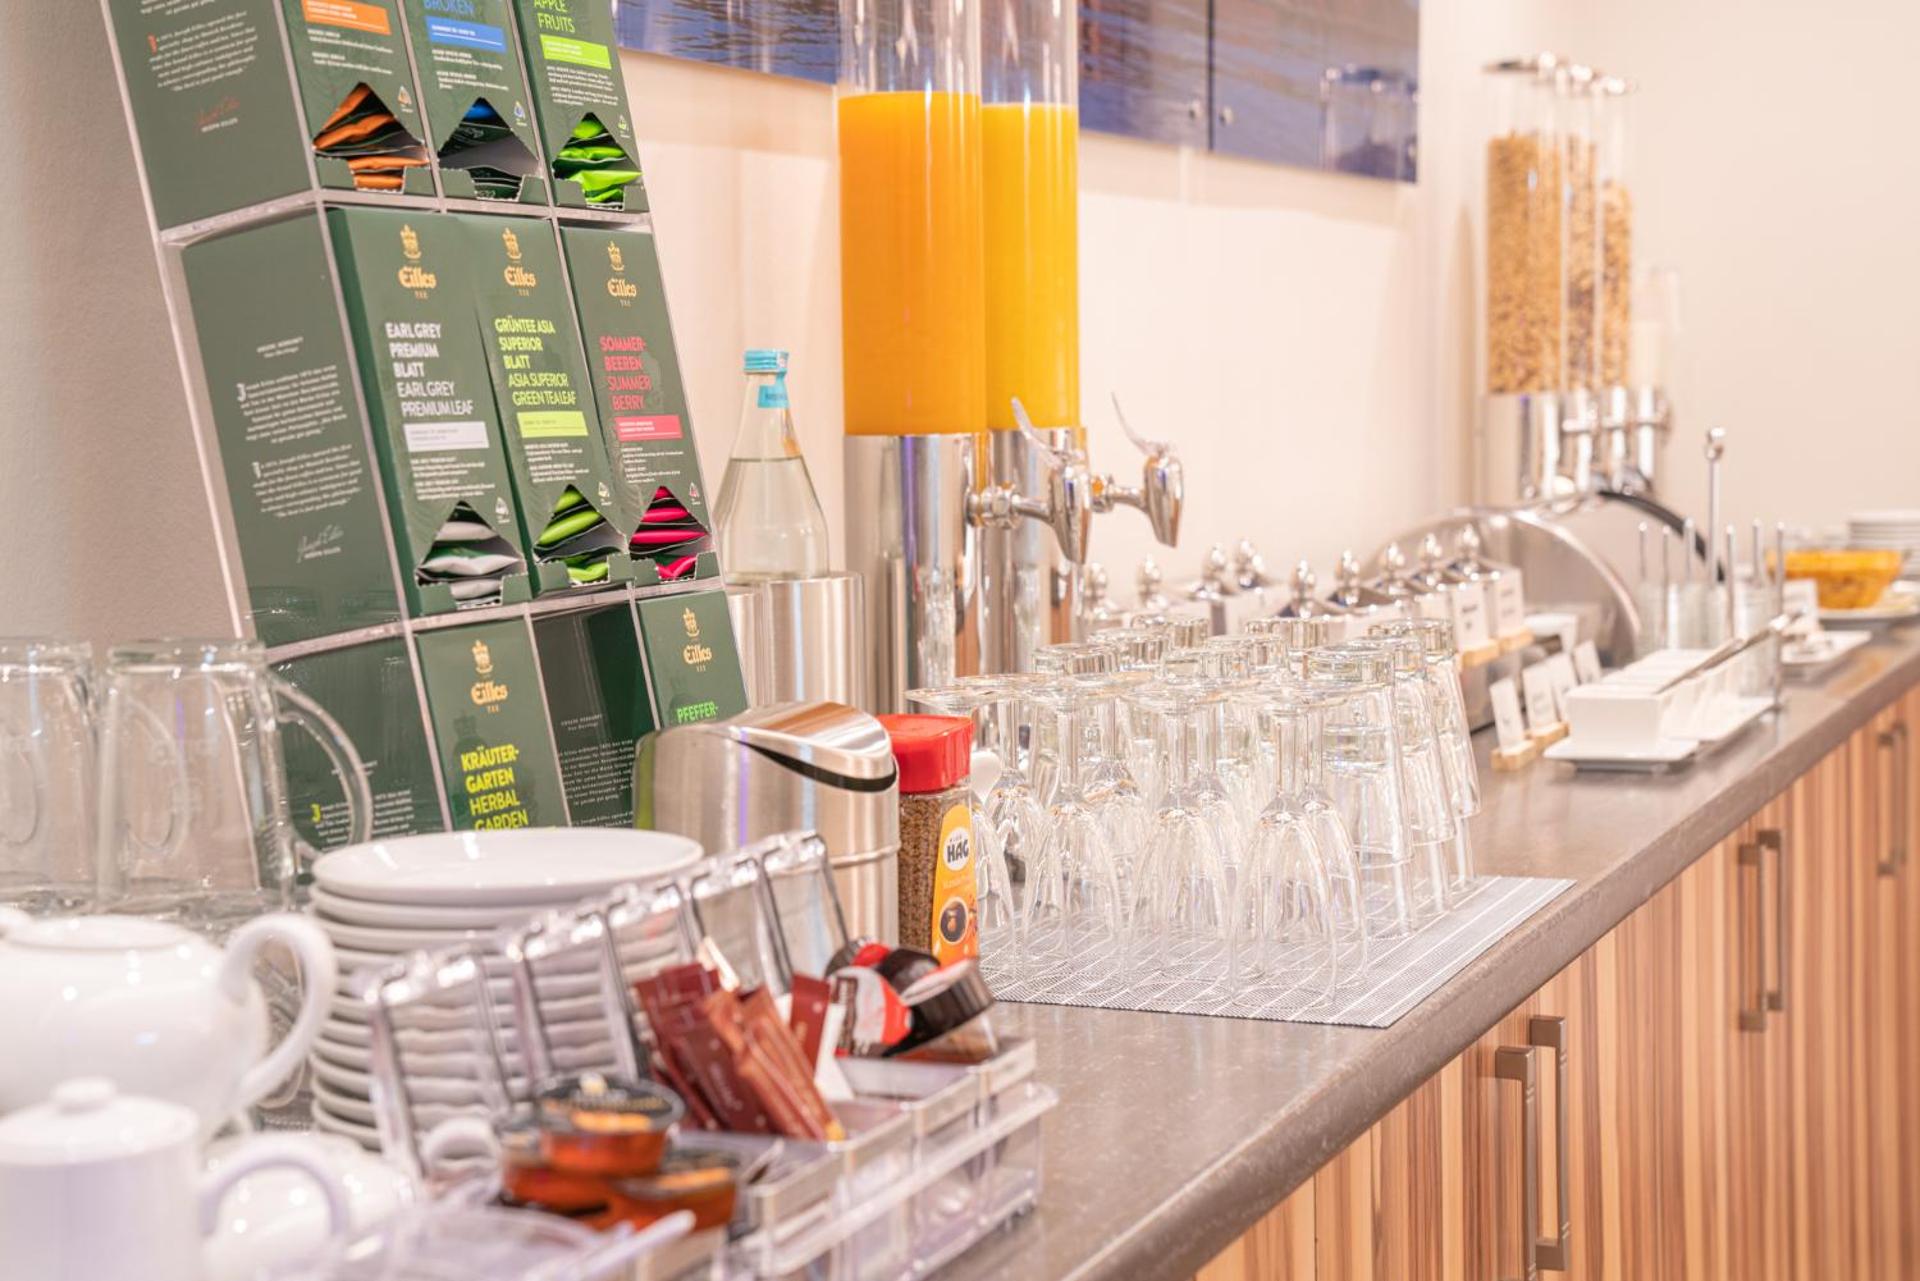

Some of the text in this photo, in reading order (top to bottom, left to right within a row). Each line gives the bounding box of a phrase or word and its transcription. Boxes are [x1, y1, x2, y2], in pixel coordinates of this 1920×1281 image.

[534, 0, 568, 13] APPLE
[537, 13, 575, 33] FRUITS
[398, 266, 437, 289] Eilles
[504, 266, 537, 288] Eilles
[607, 278, 637, 297] Eilles
[385, 322, 441, 338] EARL GREY
[495, 314, 557, 334] GRÜNTEE ASIA
[389, 342, 440, 358] PREMIUM
[499, 336, 544, 351] SUPERIOR
[393, 362, 424, 378] BLATT
[503, 355, 531, 369] BLATT
[604, 356, 642, 371] BEEREN
[397, 381, 455, 397] EARL GREY
[508, 372, 569, 388] ASIA SUPERIOR
[608, 374, 653, 391] SUMMER
[512, 391, 545, 406] GREEN
[612, 394, 644, 410] BERRY
[401, 399, 474, 417] PREMIUM LEAF
[683, 643, 713, 664] Eilles
[471, 678, 508, 706] Eilles
[677, 701, 719, 724] PFEFFER-
[461, 744, 520, 772] KRÄUTER-
[465, 768, 515, 794] GARTEN
[470, 789, 520, 816] HERBAL
[474, 808, 528, 832] GARDEN
[947, 839, 969, 863] HAG
